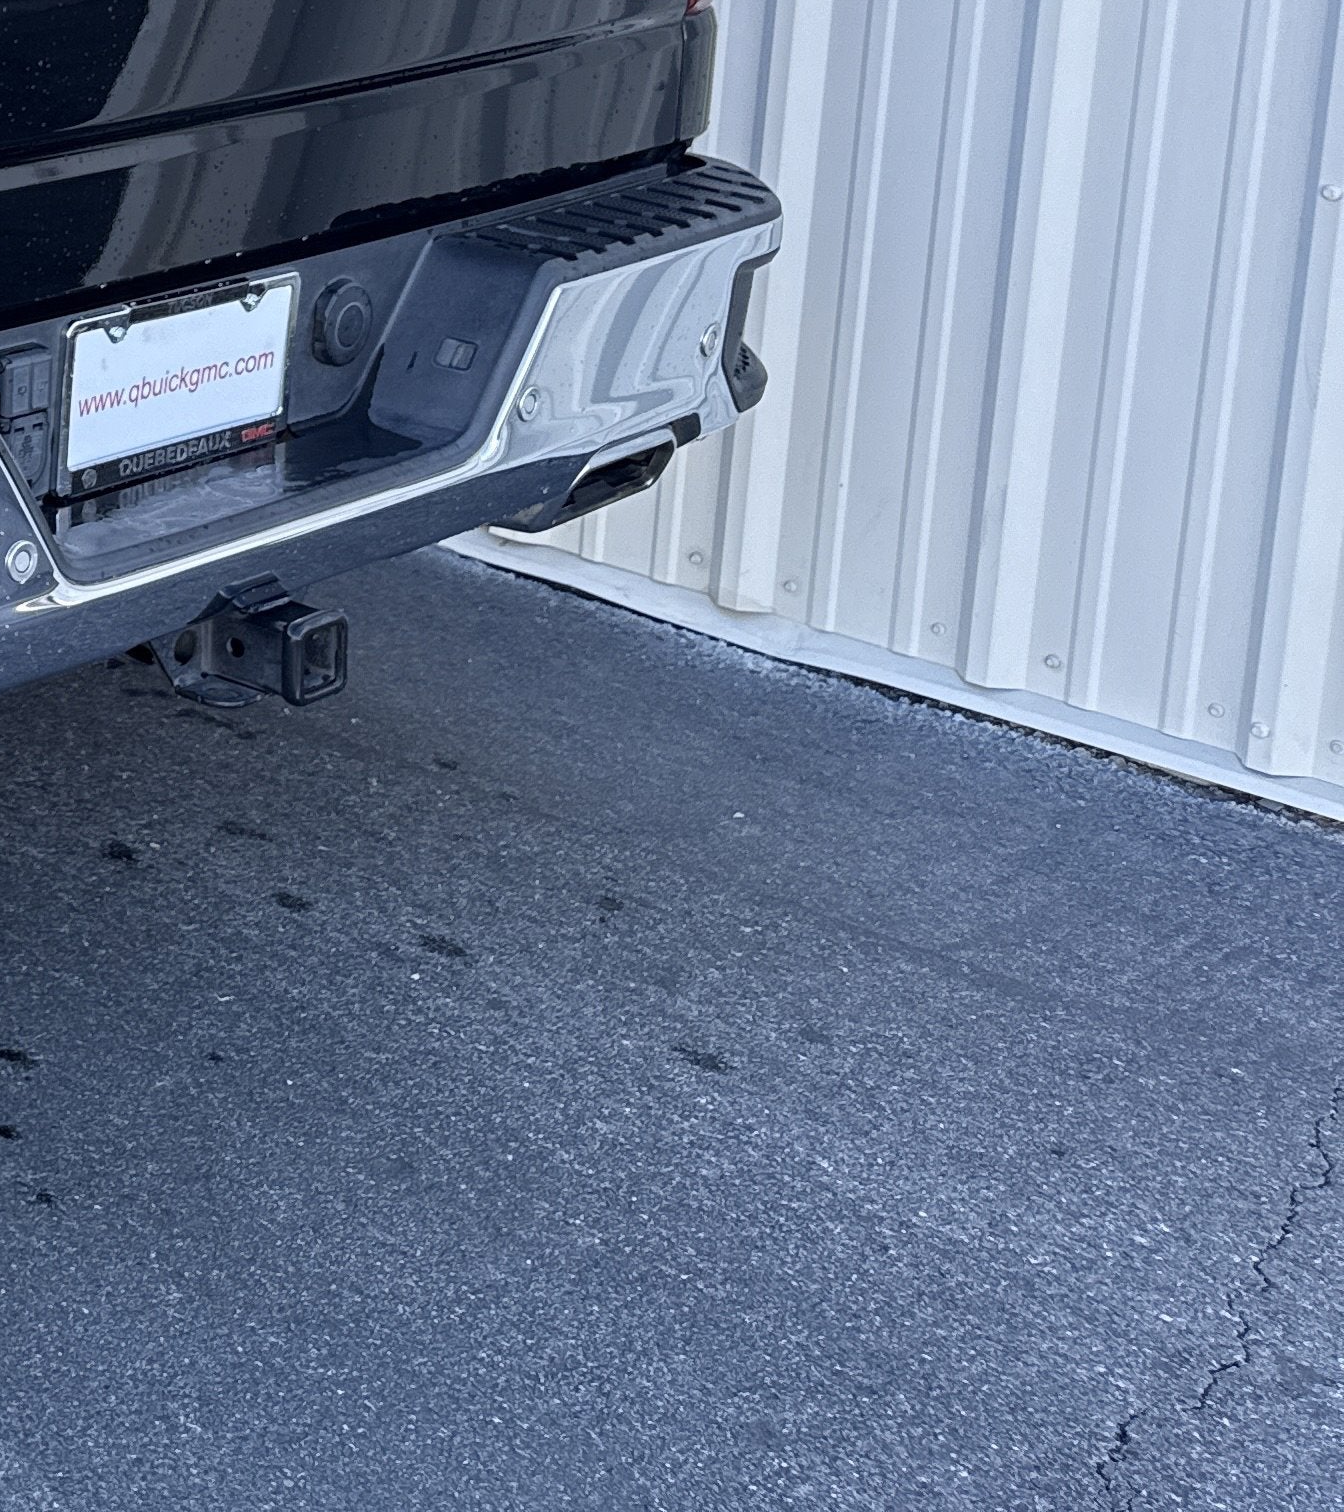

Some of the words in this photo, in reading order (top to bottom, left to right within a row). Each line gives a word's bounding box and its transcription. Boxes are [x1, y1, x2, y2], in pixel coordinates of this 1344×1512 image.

[78, 350, 275, 418] www.qbuickgmc.com
[118, 431, 232, 477] QUEBEDEAUX
[241, 423, 275, 443] GMC
